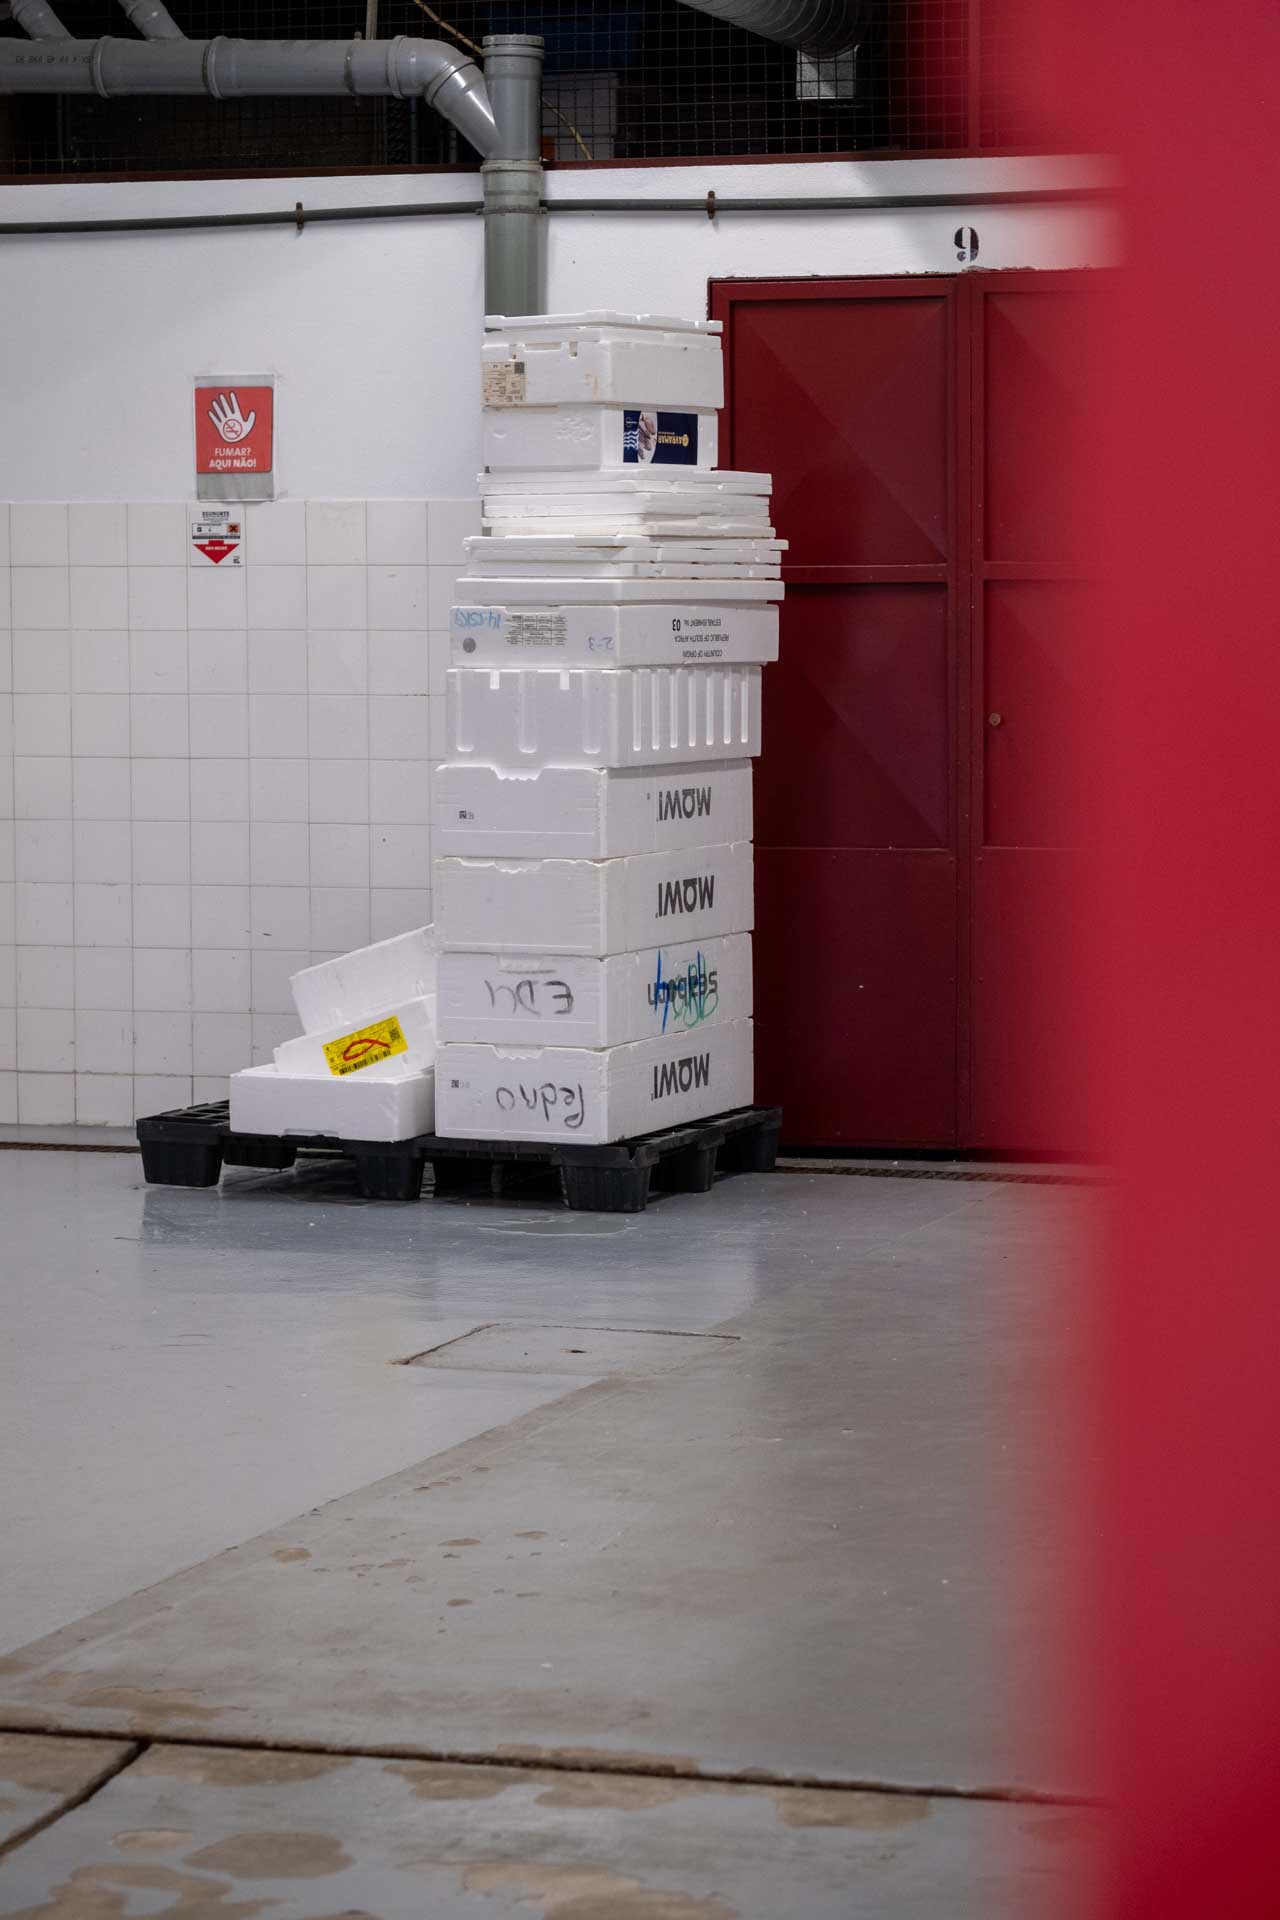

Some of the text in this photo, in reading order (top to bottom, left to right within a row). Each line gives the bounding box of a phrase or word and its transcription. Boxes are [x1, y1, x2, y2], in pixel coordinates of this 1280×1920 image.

[954, 226, 979, 262] 9
[657, 434, 683, 445] AVRAMAR
[214, 447, 251, 457] FUMAR?
[209, 456, 257, 470] AQUI NÃO!
[672, 618, 681, 631] 03
[674, 635, 689, 643] AFRICA
[689, 634, 703, 642] SOUTH
[710, 633, 729, 642] REPUBLIC
[682, 649, 723, 658] COUNTRY OF ORIGIN
[658, 786, 712, 821] MOWI
[658, 875, 715, 917] MOWI
[654, 1053, 710, 1099] MOWI
